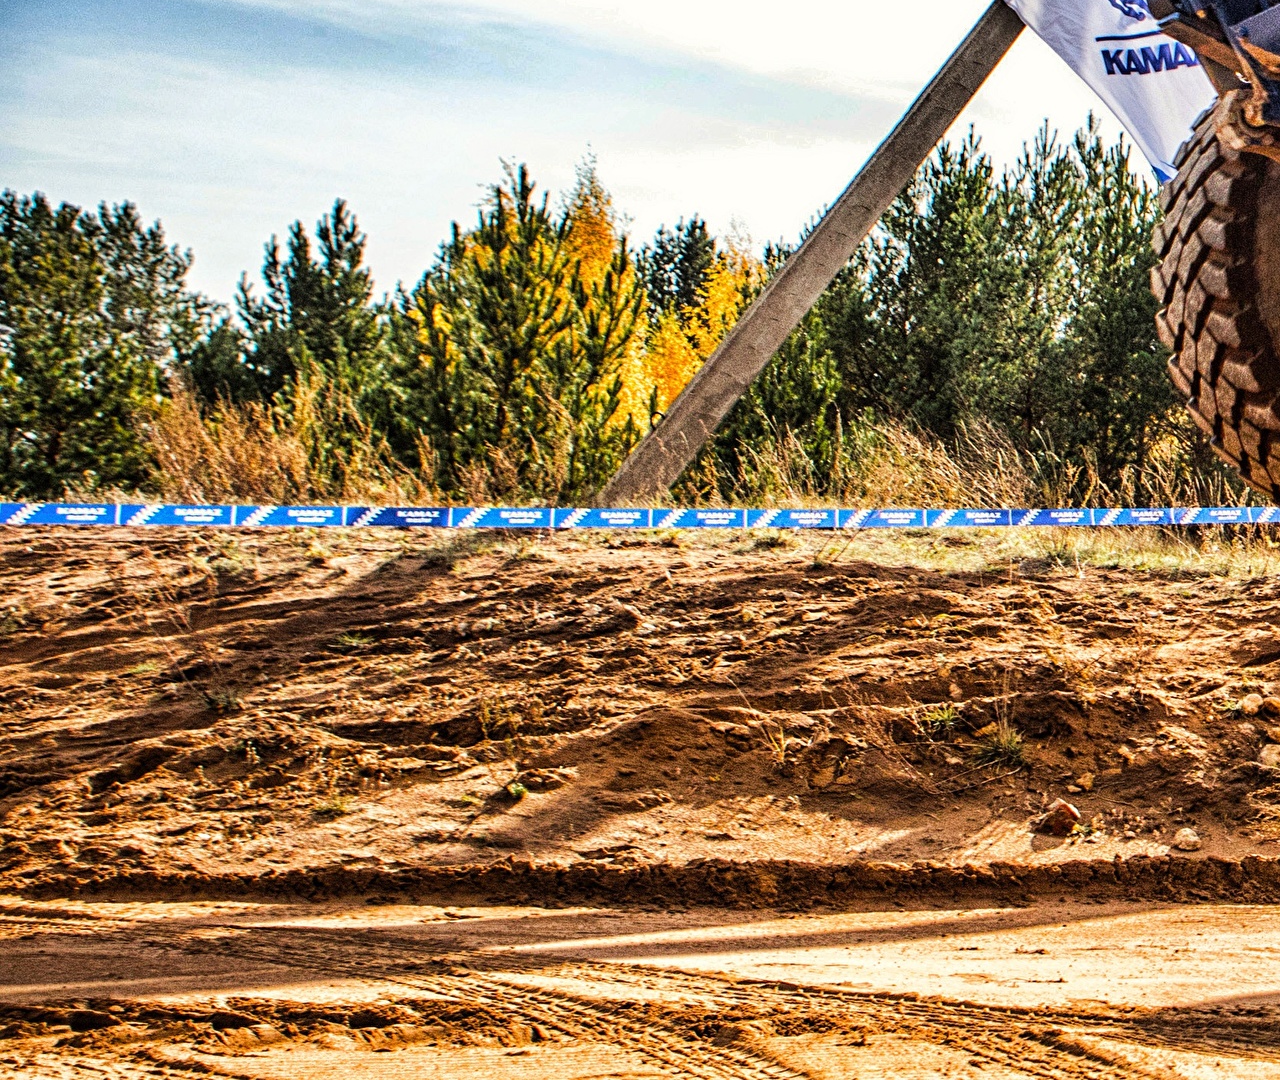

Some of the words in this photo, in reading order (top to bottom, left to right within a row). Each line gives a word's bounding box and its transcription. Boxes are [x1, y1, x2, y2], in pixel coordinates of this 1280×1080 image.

[1101, 41, 1199, 75] KAMA
[56, 507, 107, 515] KAMAZ
[174, 508, 223, 516] KAMAZ
[287, 509, 334, 517] KAMAZ
[396, 510, 440, 518] KAMAZ
[500, 510, 543, 519] KAMAZ
[600, 511, 641, 519] KAMAZ
[697, 511, 736, 519] KAMAZ
[790, 511, 828, 519] KAMAZ
[879, 511, 916, 519] KAMAZ
[966, 511, 1001, 519] KAMAZ
[1130, 510, 1164, 518] KAMAZ
[1210, 509, 1242, 517] KAMAZ
